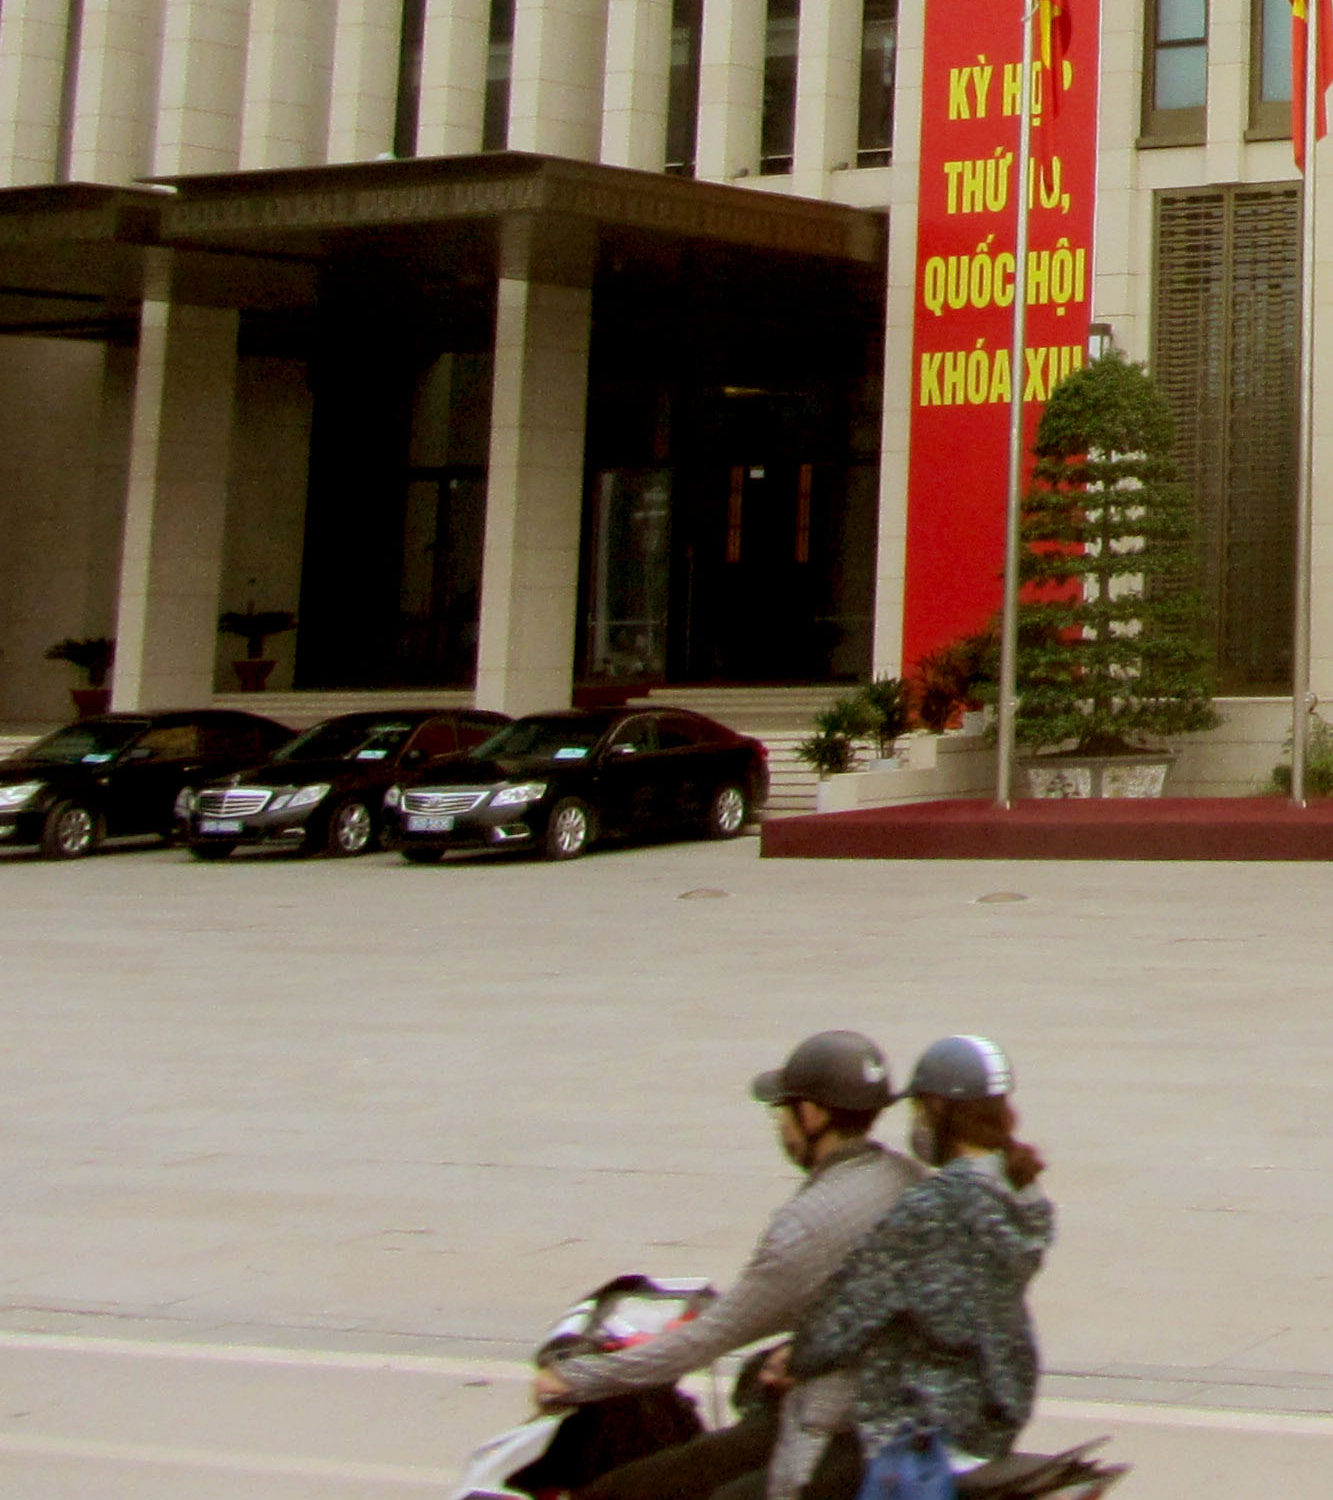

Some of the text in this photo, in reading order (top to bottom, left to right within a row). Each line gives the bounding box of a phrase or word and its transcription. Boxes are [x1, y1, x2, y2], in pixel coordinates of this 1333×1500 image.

[949, 54, 993, 120] KỲ
[944, 146, 1013, 214] THỨ
[924, 234, 1085, 316] QUỐC HỘI
[920, 338, 1013, 406] KHÓA
